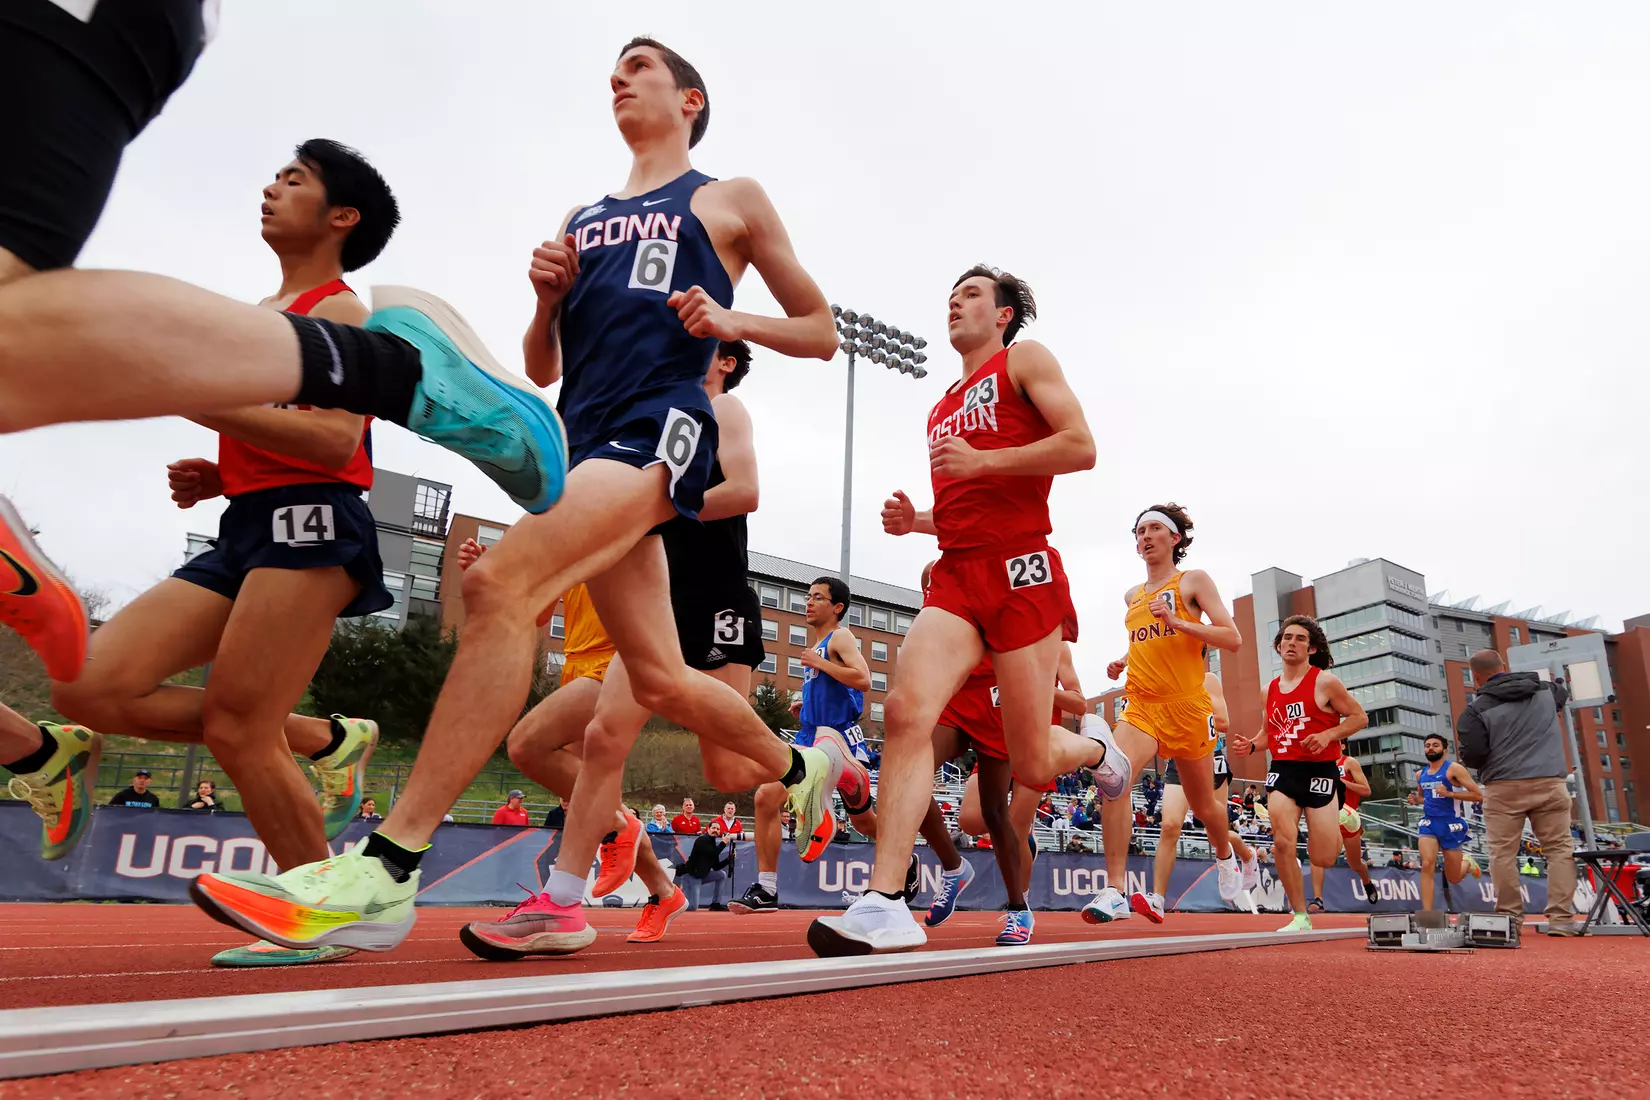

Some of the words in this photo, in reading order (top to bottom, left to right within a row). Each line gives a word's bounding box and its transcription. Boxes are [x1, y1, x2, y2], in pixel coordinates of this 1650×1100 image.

[636, 242, 669, 286] 6
[964, 377, 995, 414] 23
[666, 417, 696, 467] 6
[928, 402, 998, 449] OSTON
[278, 506, 328, 540] 14
[1010, 553, 1048, 588] 23
[718, 610, 739, 642] 3
[1130, 622, 1177, 643] IONA
[1287, 703, 1302, 719] 20
[847, 724, 863, 744] 18
[1310, 778, 1330, 793] 20
